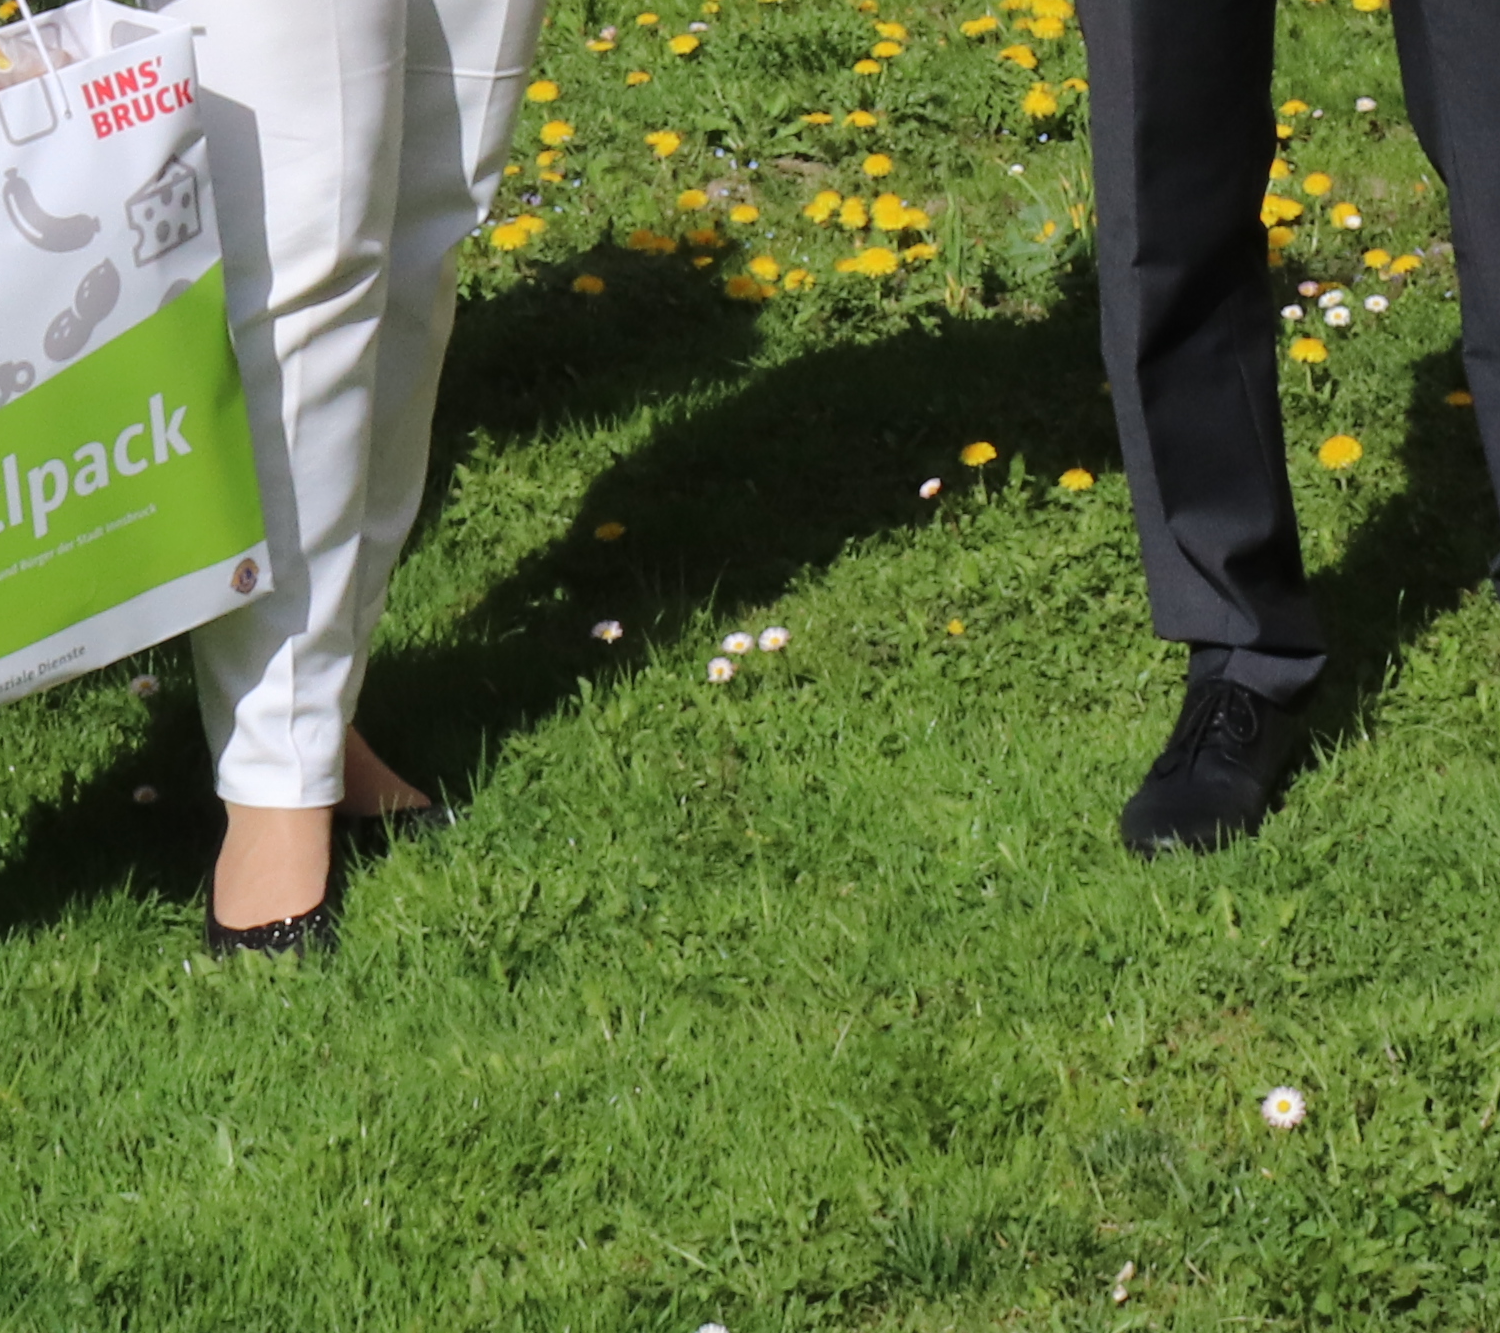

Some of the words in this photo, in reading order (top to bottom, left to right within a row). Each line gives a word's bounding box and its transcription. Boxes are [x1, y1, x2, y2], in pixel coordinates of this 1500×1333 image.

[91, 78, 194, 140] BRUCK
[19, 549, 55, 571] Bürger
[57, 539, 75, 556] der
[38, 645, 86, 676] Dienste
